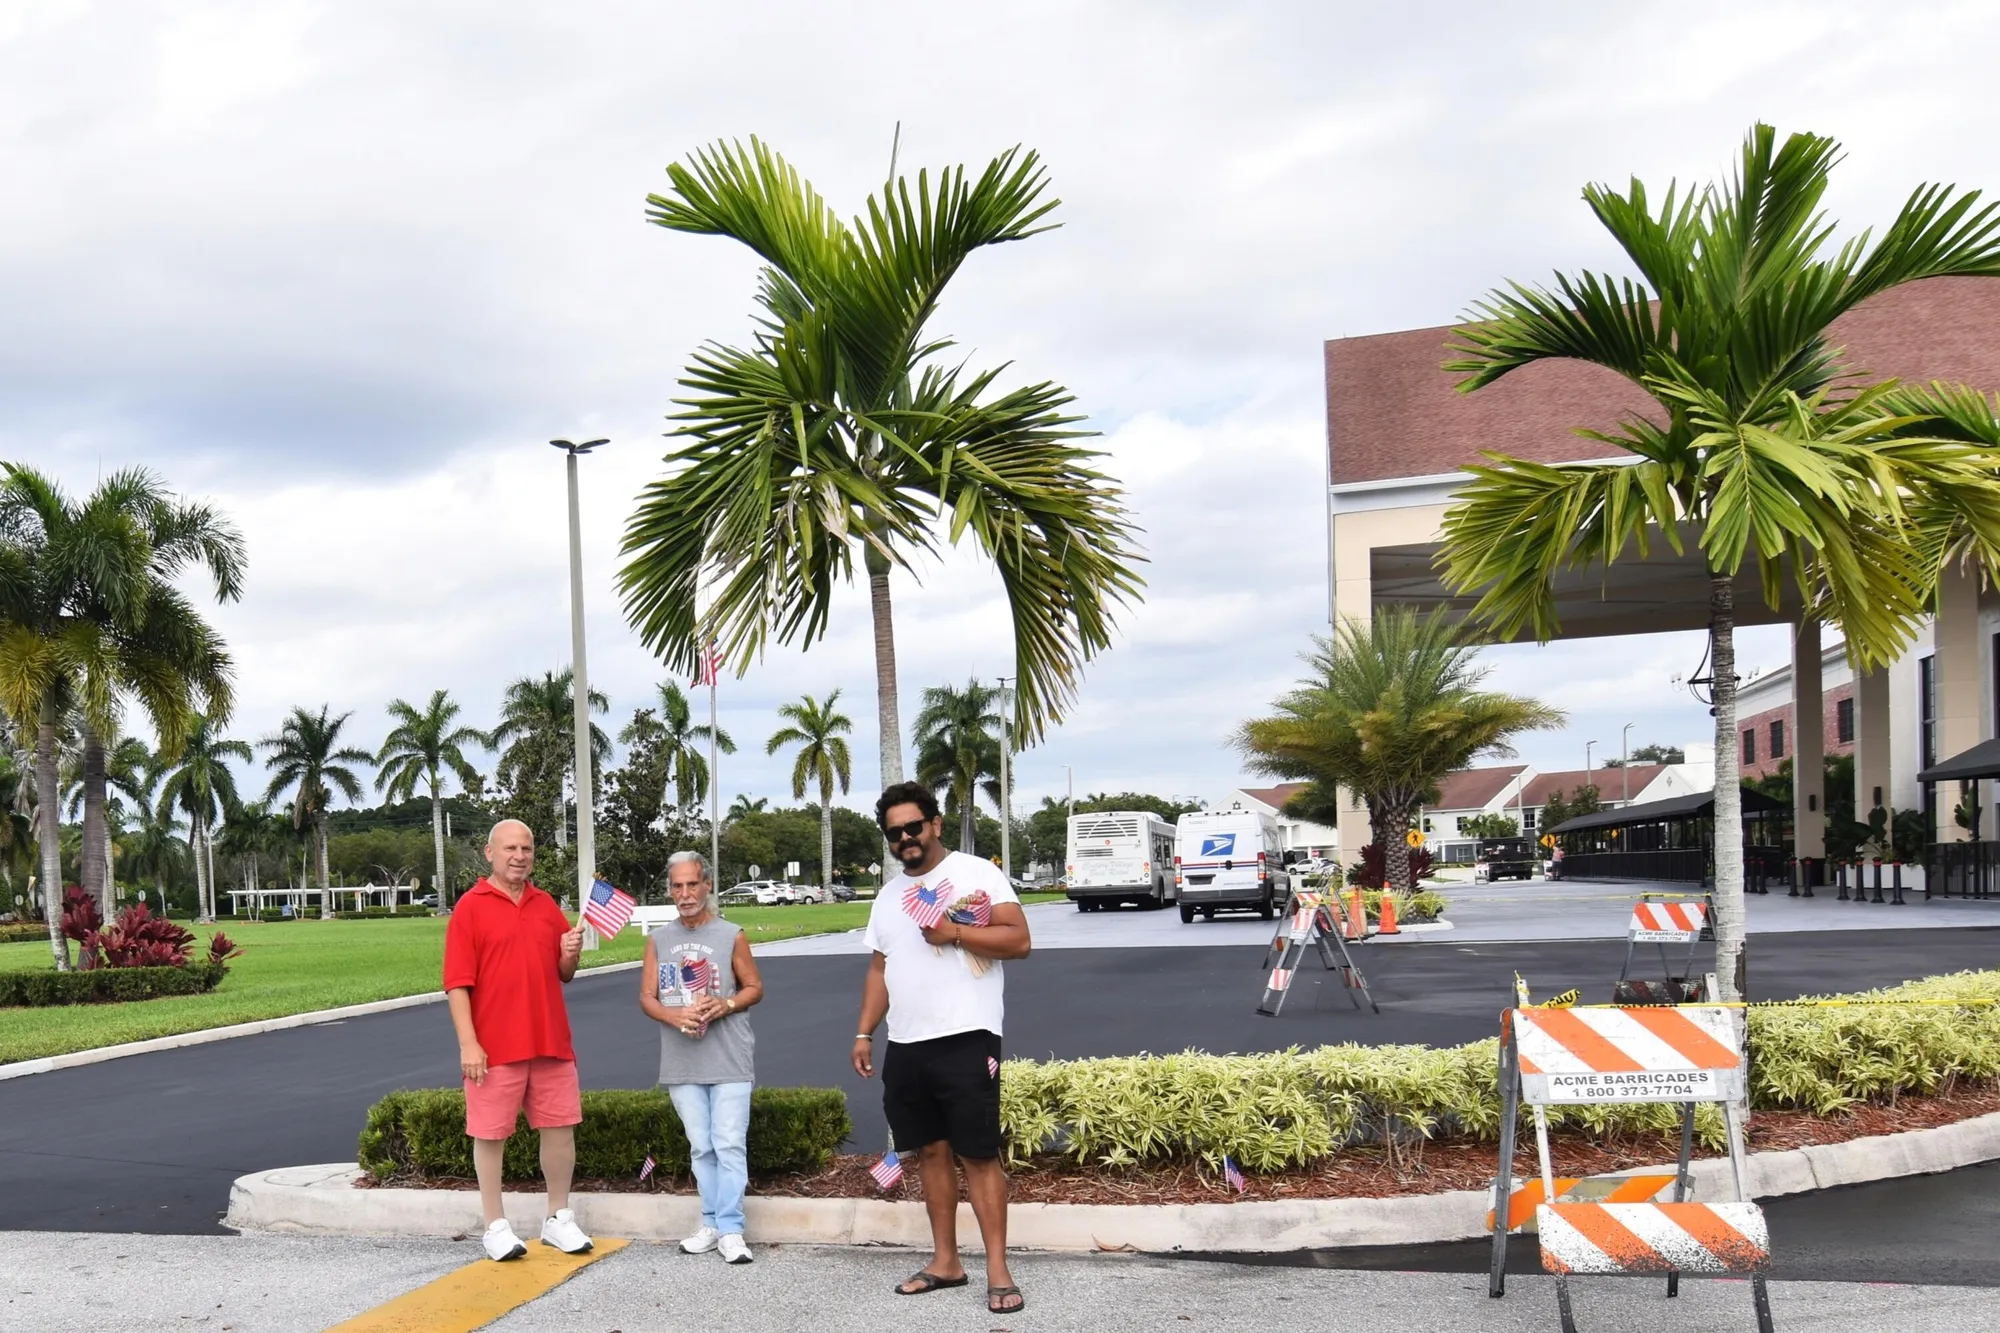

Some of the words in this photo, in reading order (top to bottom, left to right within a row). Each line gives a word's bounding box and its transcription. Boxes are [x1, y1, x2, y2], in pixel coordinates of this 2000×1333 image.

[670, 944, 683, 954] LAND
[1553, 1075, 1599, 1086] ACME
[1604, 1072, 1708, 1085] BARRICADES
[1586, 1087, 1615, 1097] 800
[1620, 1085, 1693, 1096] 373-7704
